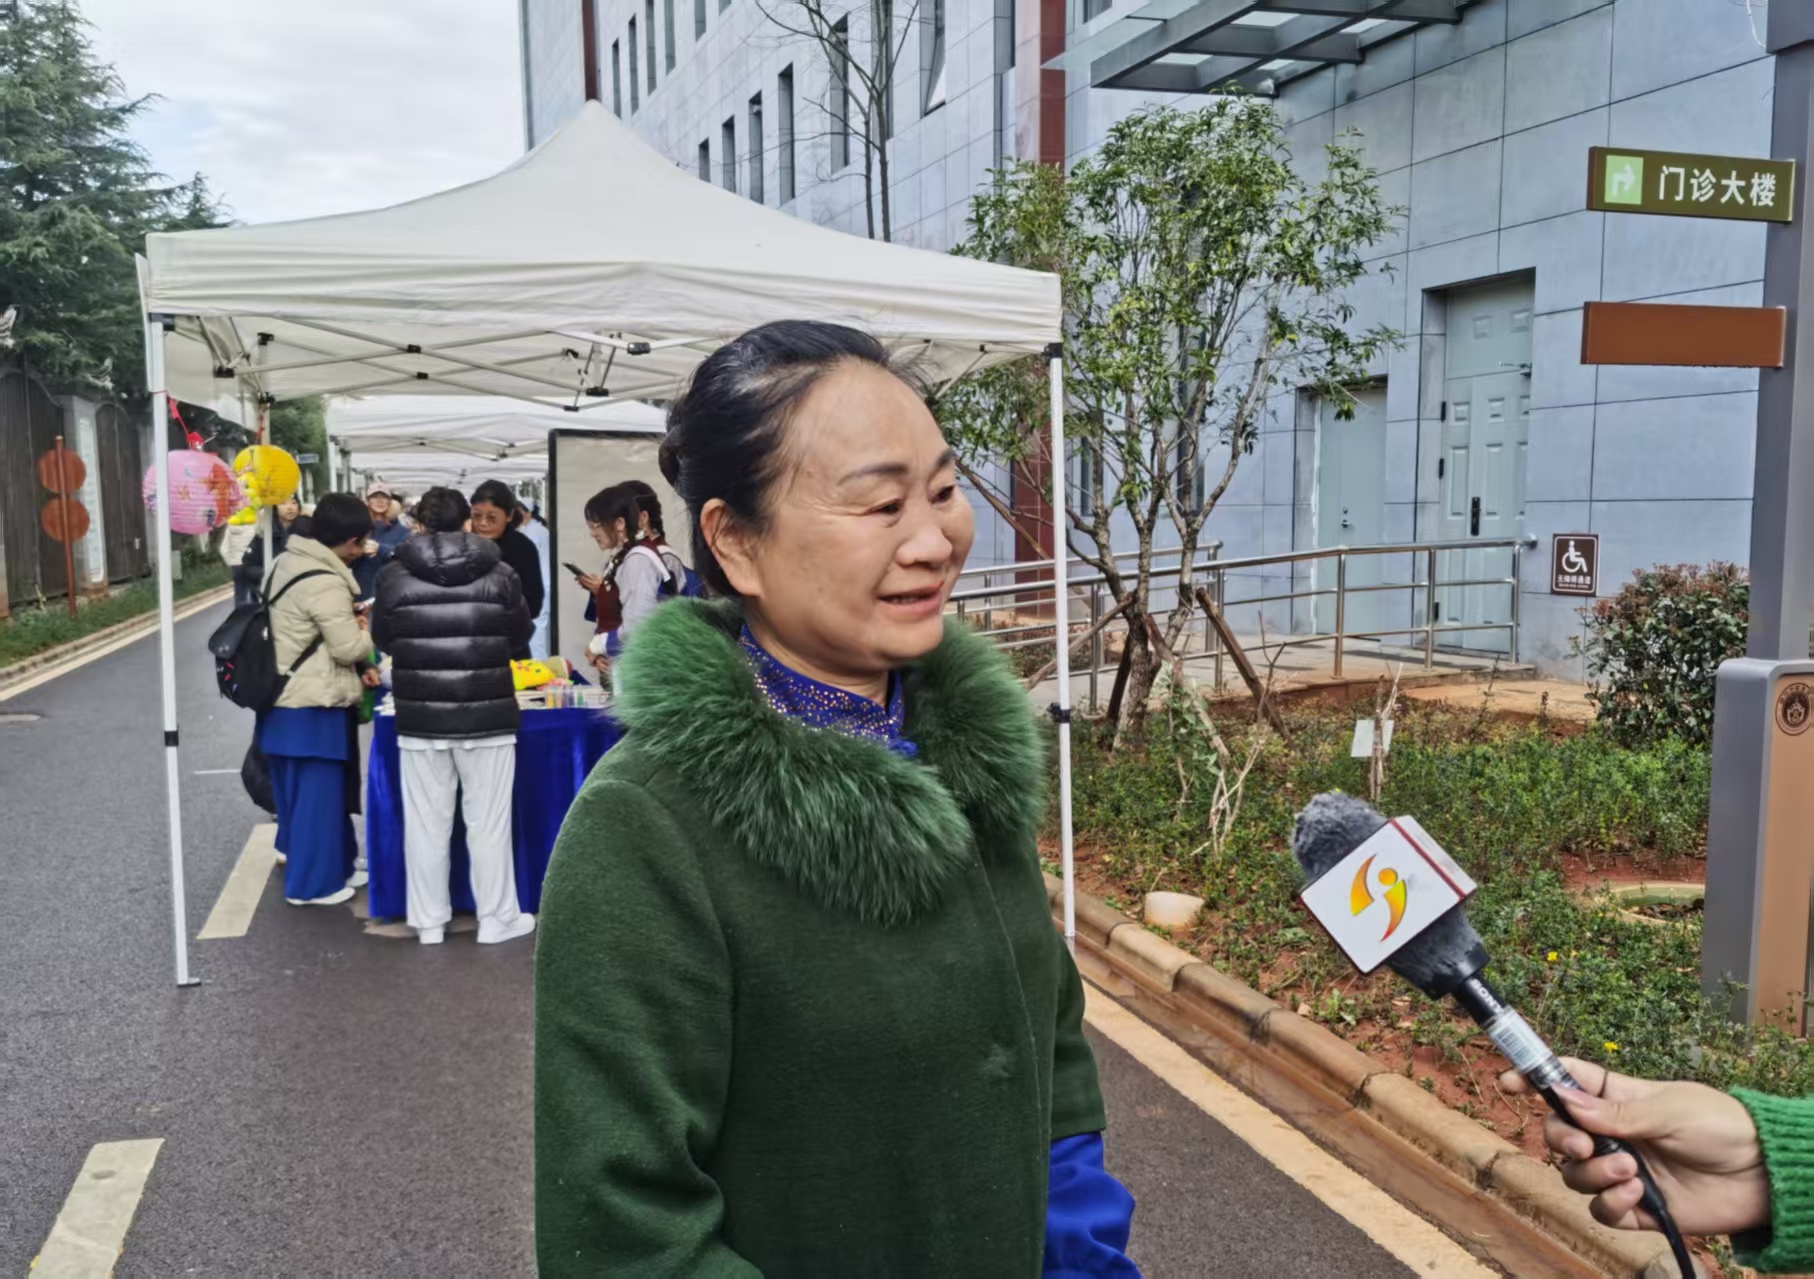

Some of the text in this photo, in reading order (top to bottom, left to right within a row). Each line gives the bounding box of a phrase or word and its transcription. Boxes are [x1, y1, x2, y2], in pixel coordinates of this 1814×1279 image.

[1658, 165, 1777, 207] 门诊大楼
[1469, 978, 1504, 1014] SONY
